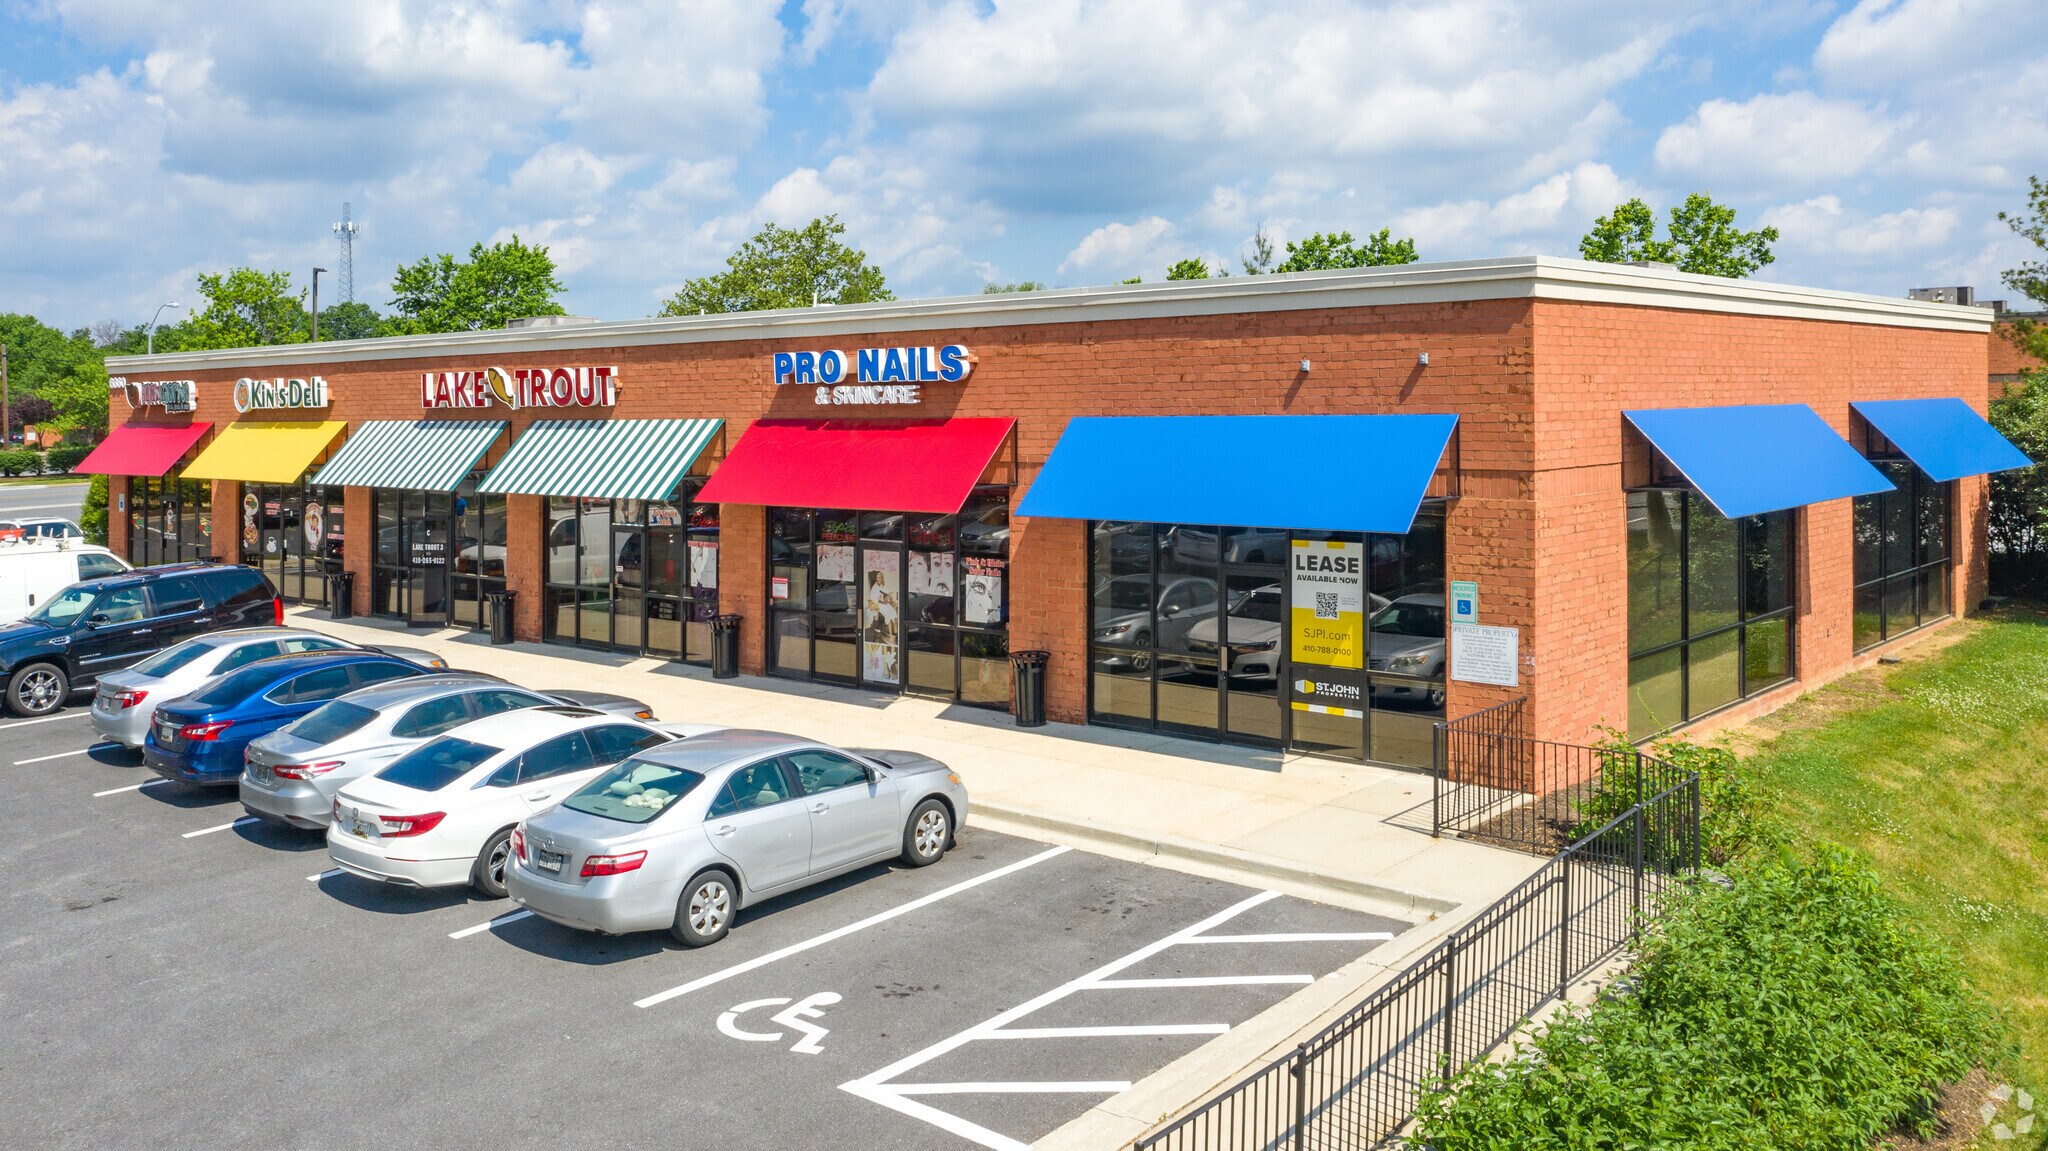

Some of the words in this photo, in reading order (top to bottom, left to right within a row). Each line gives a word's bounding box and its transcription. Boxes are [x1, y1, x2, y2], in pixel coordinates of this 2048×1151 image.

[774, 349, 845, 384] PRO
[858, 345, 968, 382] NAILS
[421, 371, 488, 408] LAKE
[514, 366, 616, 408] TROUT
[815, 386, 830, 405] &
[833, 385, 918, 405] SKINCARE
[426, 529, 431, 537] C
[412, 543, 424, 551] LAKE
[425, 543, 440, 551] TROUT
[1295, 554, 1359, 574] LEASE
[1296, 574, 1338, 583] AVAILABLE
[1340, 577, 1359, 585] NOW
[1251, 590, 1257, 598] F
[1303, 628, 1351, 642] SJPI.com
[1454, 626, 1480, 635] PRIVATE
[1482, 628, 1515, 638] PROPERTY
[1302, 645, 1352, 656] 410-788-0100
[1316, 690, 1360, 700] PROPERTIES
